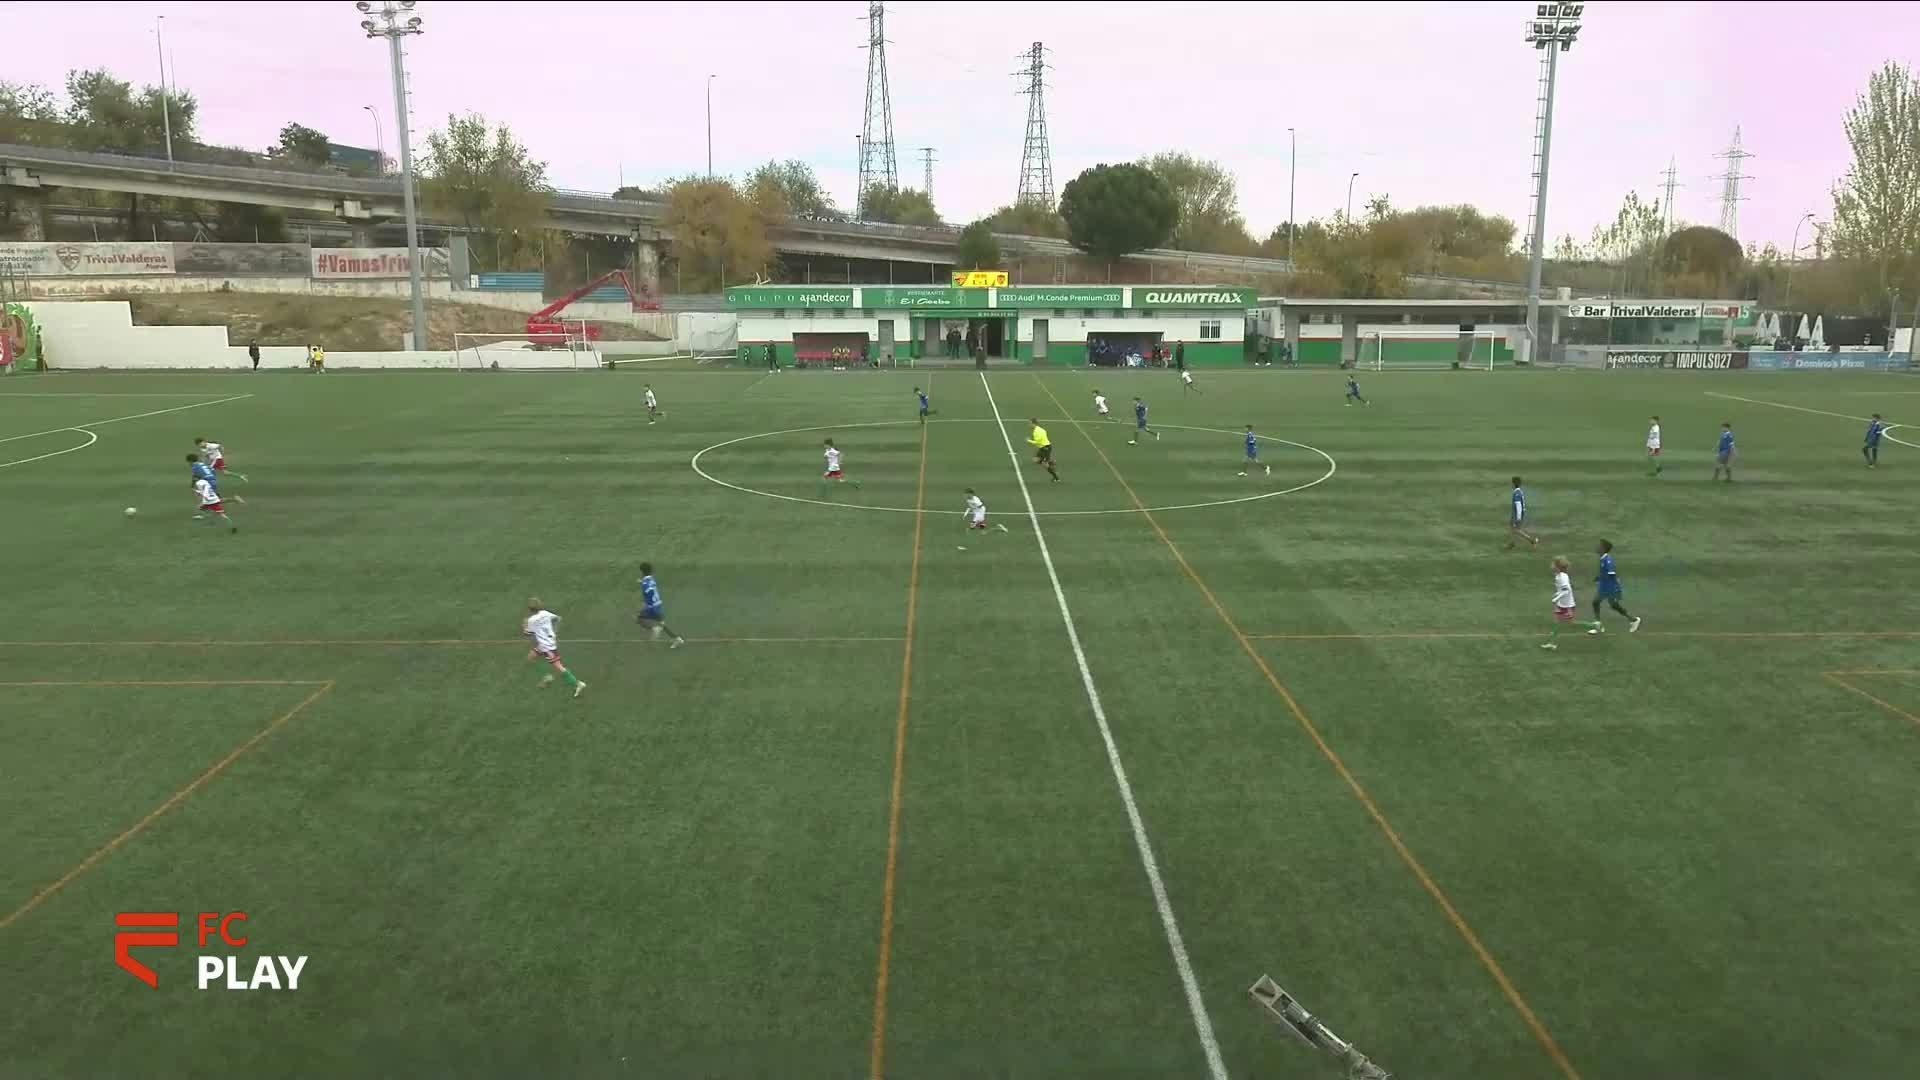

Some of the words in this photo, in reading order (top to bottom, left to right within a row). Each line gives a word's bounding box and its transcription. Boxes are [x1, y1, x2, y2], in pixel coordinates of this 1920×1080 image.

[86, 254, 167, 264] TrivalValderas
[318, 253, 425, 273] #VamosTrivl
[1069, 294, 1103, 302] Premium
[1145, 292, 1243, 304] QUAMTRAX
[1584, 306, 1606, 316] Bar
[1612, 305, 1697, 317] TrivalValderas
[1676, 352, 1732, 369] IMPULSO27
[1795, 359, 1838, 368] Domino's
[1840, 359, 1865, 368] Pizza
